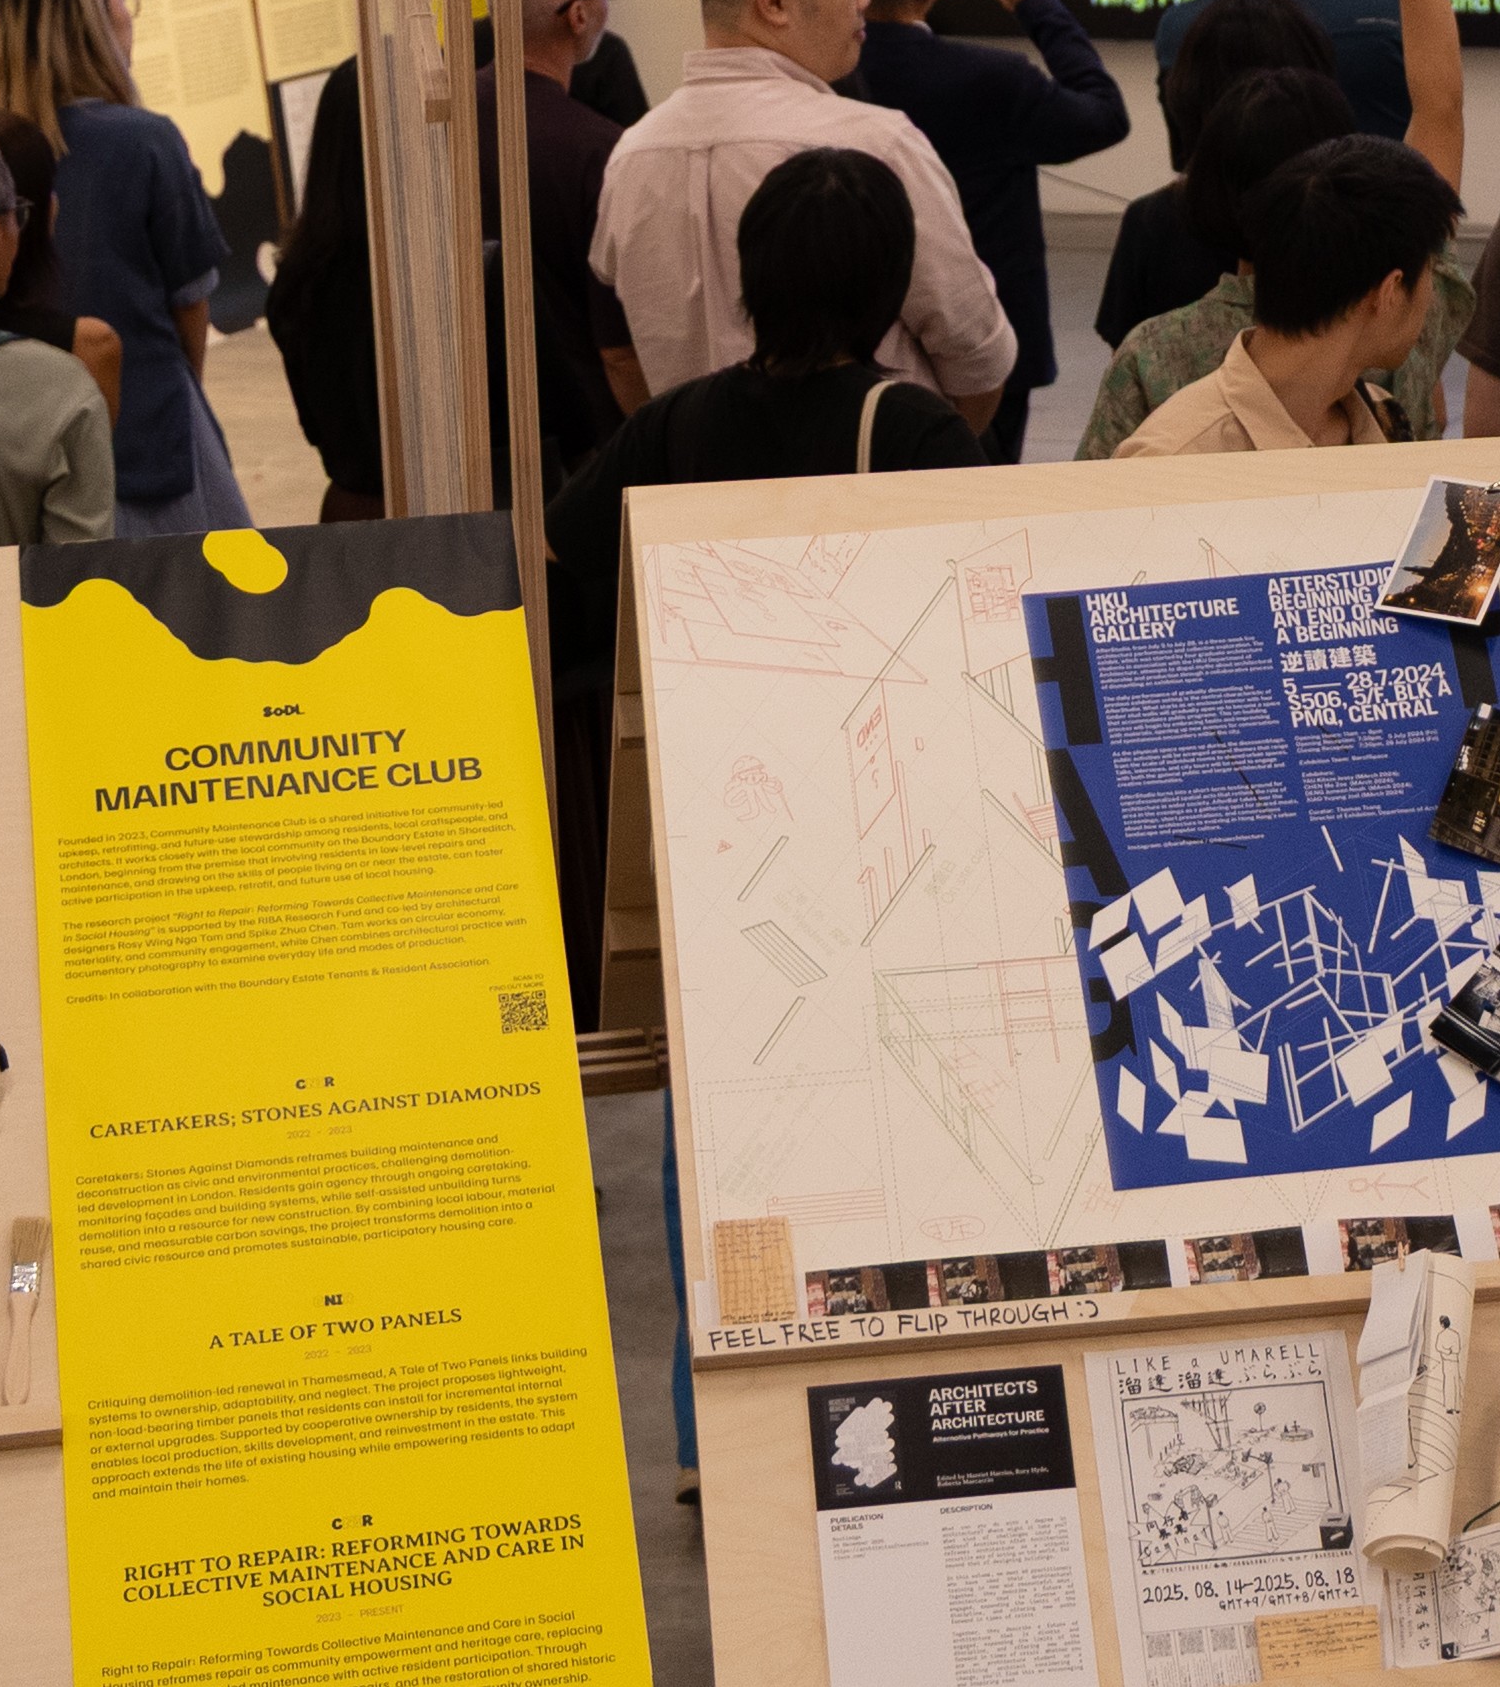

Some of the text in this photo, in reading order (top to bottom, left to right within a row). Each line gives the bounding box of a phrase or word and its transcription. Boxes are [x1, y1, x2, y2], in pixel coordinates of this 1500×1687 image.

[1086, 592, 1129, 612] HKU
[1089, 598, 1240, 627] ARCHITECTURE
[1269, 586, 1372, 612] BEGINNING
[1274, 603, 1374, 629] AN END OF
[1092, 621, 1177, 644] GALLERY
[1276, 617, 1399, 645] A BEGINNING
[1282, 662, 1445, 695] 5 28.7.2024
[1288, 690, 1348, 711] S506,
[1395, 681, 1431, 700] BLK
[1438, 677, 1452, 696] A
[1290, 700, 1439, 728] PMQ, CENTRAL
[165, 729, 406, 771] COMMUNITY
[95, 757, 483, 813] MAINTENANCE CLUB
[89, 1082, 541, 1139] CARETAKERS; STONES AGAINST DIAMONDS
[209, 1309, 463, 1350] A TALE OF TWO PANELS
[708, 1326, 776, 1352] FEEL
[784, 1320, 841, 1345] FREE
[850, 1316, 885, 1338] TO
[898, 1314, 948, 1334] FLIP
[957, 1301, 1070, 1329] THROUGH
[1115, 1356, 1172, 1376] LIKE
[1220, 1343, 1320, 1365] UMARELL
[928, 1380, 1038, 1403] ARCHITECTS
[930, 1399, 987, 1417] AFTER
[931, 1409, 1045, 1431] ARCHITECTURE
[92, 1475, 248, 1501] and maintain their homes.
[939, 1503, 994, 1515] DESCRIPTION
[124, 1514, 582, 1583] RIGHT TO REPAIR: REFORMING TOWARDS
[122, 1534, 584, 1603] COLLECTIVE MAINTENANCE AND CARE IN
[262, 1570, 453, 1608] SOCIAL HOUSING
